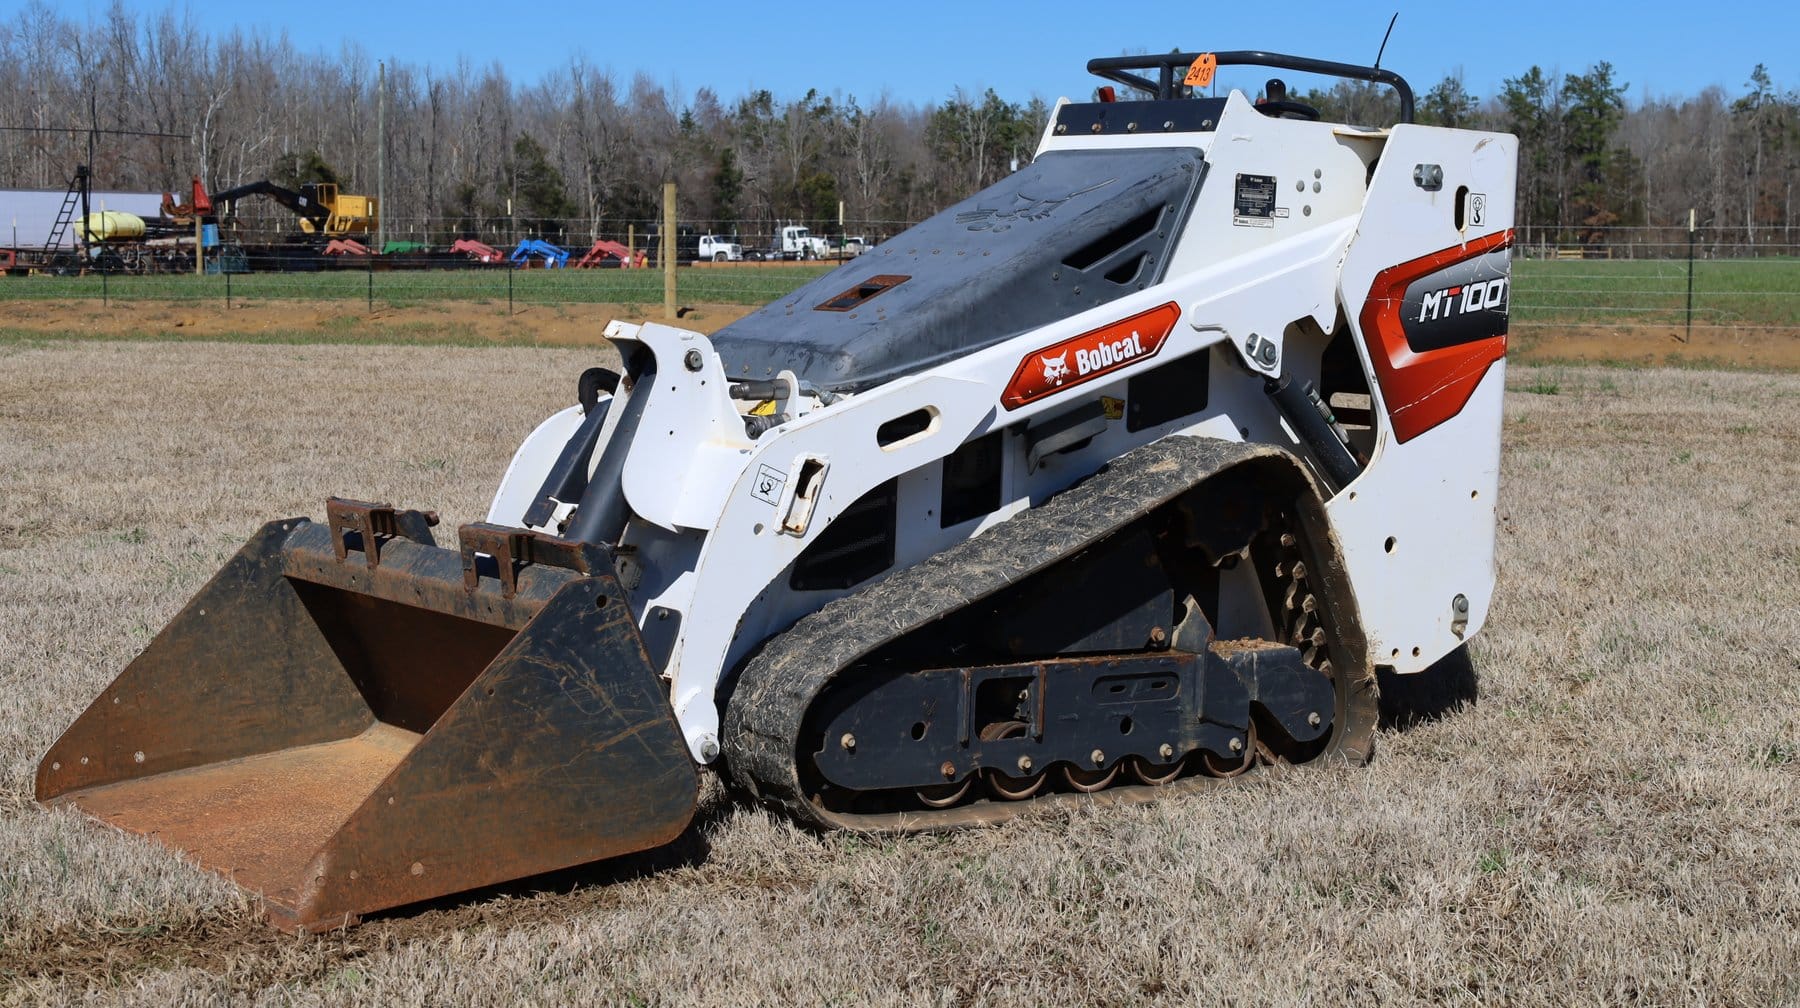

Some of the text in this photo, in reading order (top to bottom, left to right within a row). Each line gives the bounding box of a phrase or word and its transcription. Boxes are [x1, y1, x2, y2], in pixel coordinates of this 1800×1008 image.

[1187, 66, 1211, 82] 2413
[1418, 278, 1504, 323] MT100
[1075, 331, 1143, 376] Bobcat
